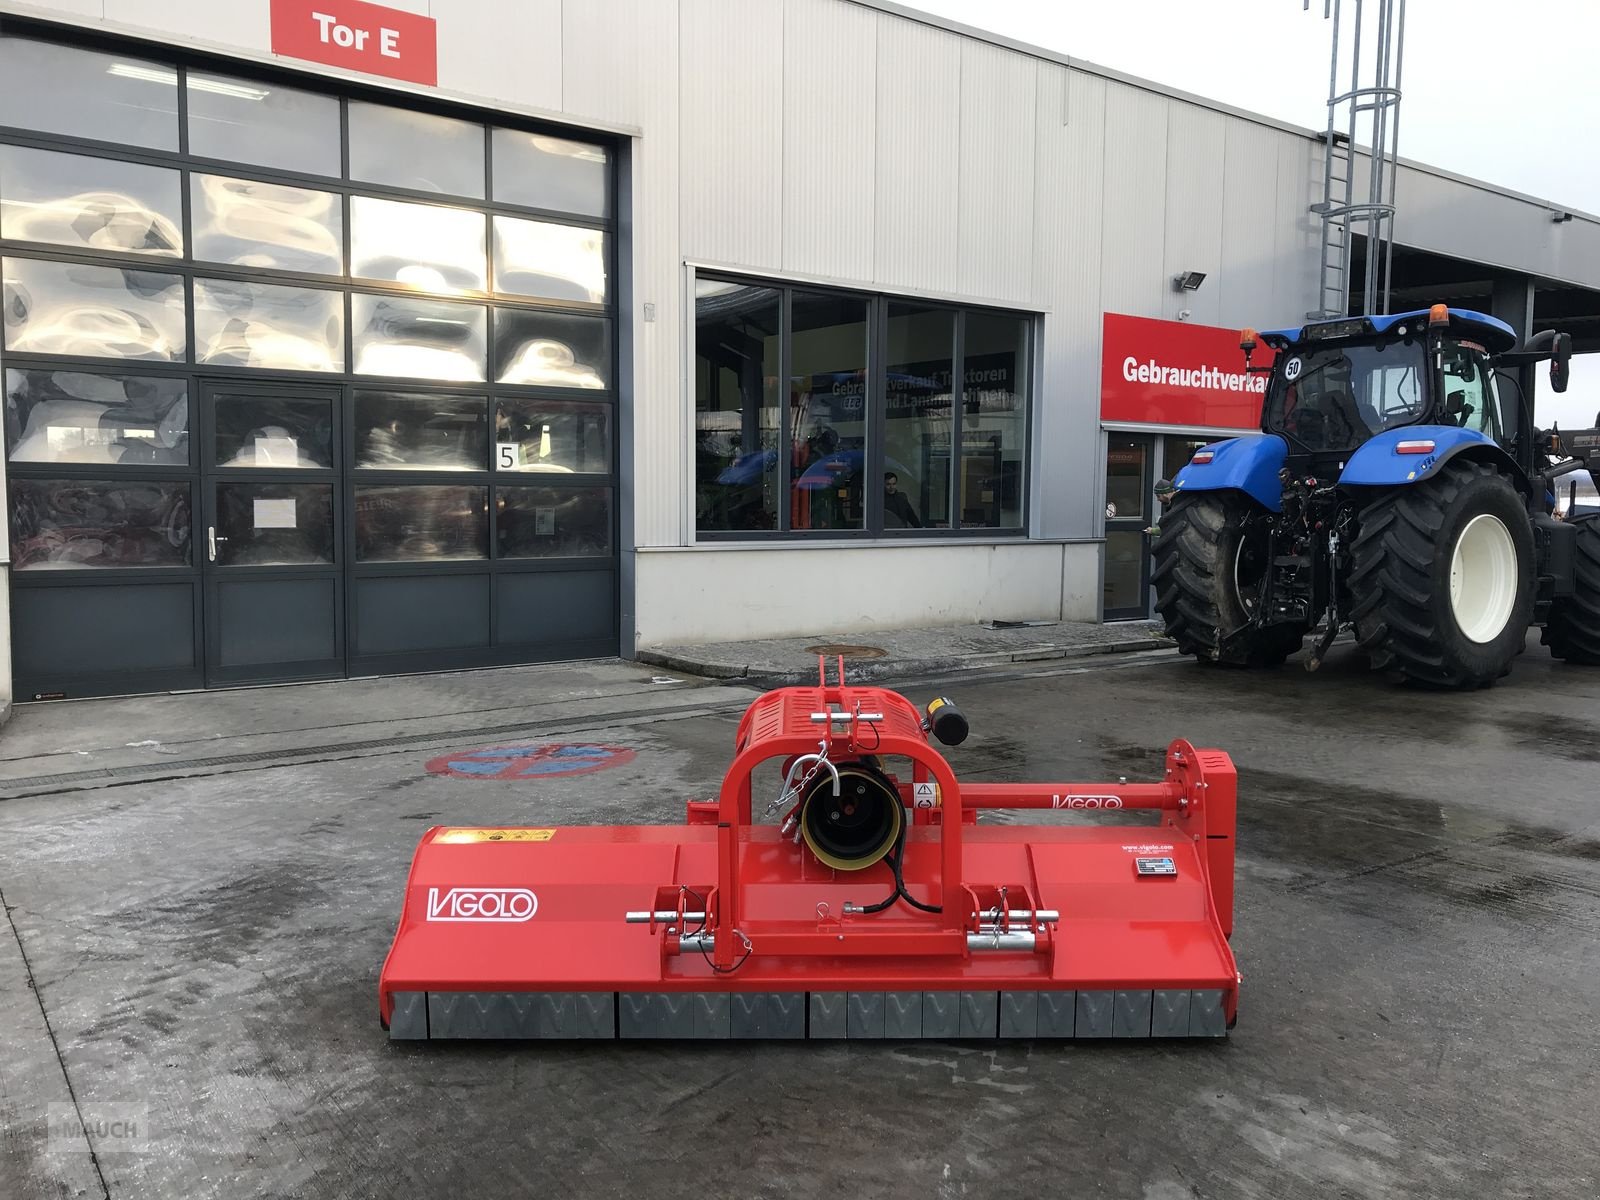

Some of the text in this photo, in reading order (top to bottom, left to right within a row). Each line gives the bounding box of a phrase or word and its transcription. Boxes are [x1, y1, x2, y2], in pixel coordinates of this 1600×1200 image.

[312, 11, 401, 59] Tor E
[1287, 361, 1300, 376] 50
[500, 446, 514, 469] 5
[1052, 794, 1123, 809] VIGOLO
[426, 887, 539, 922] VIGOLO
